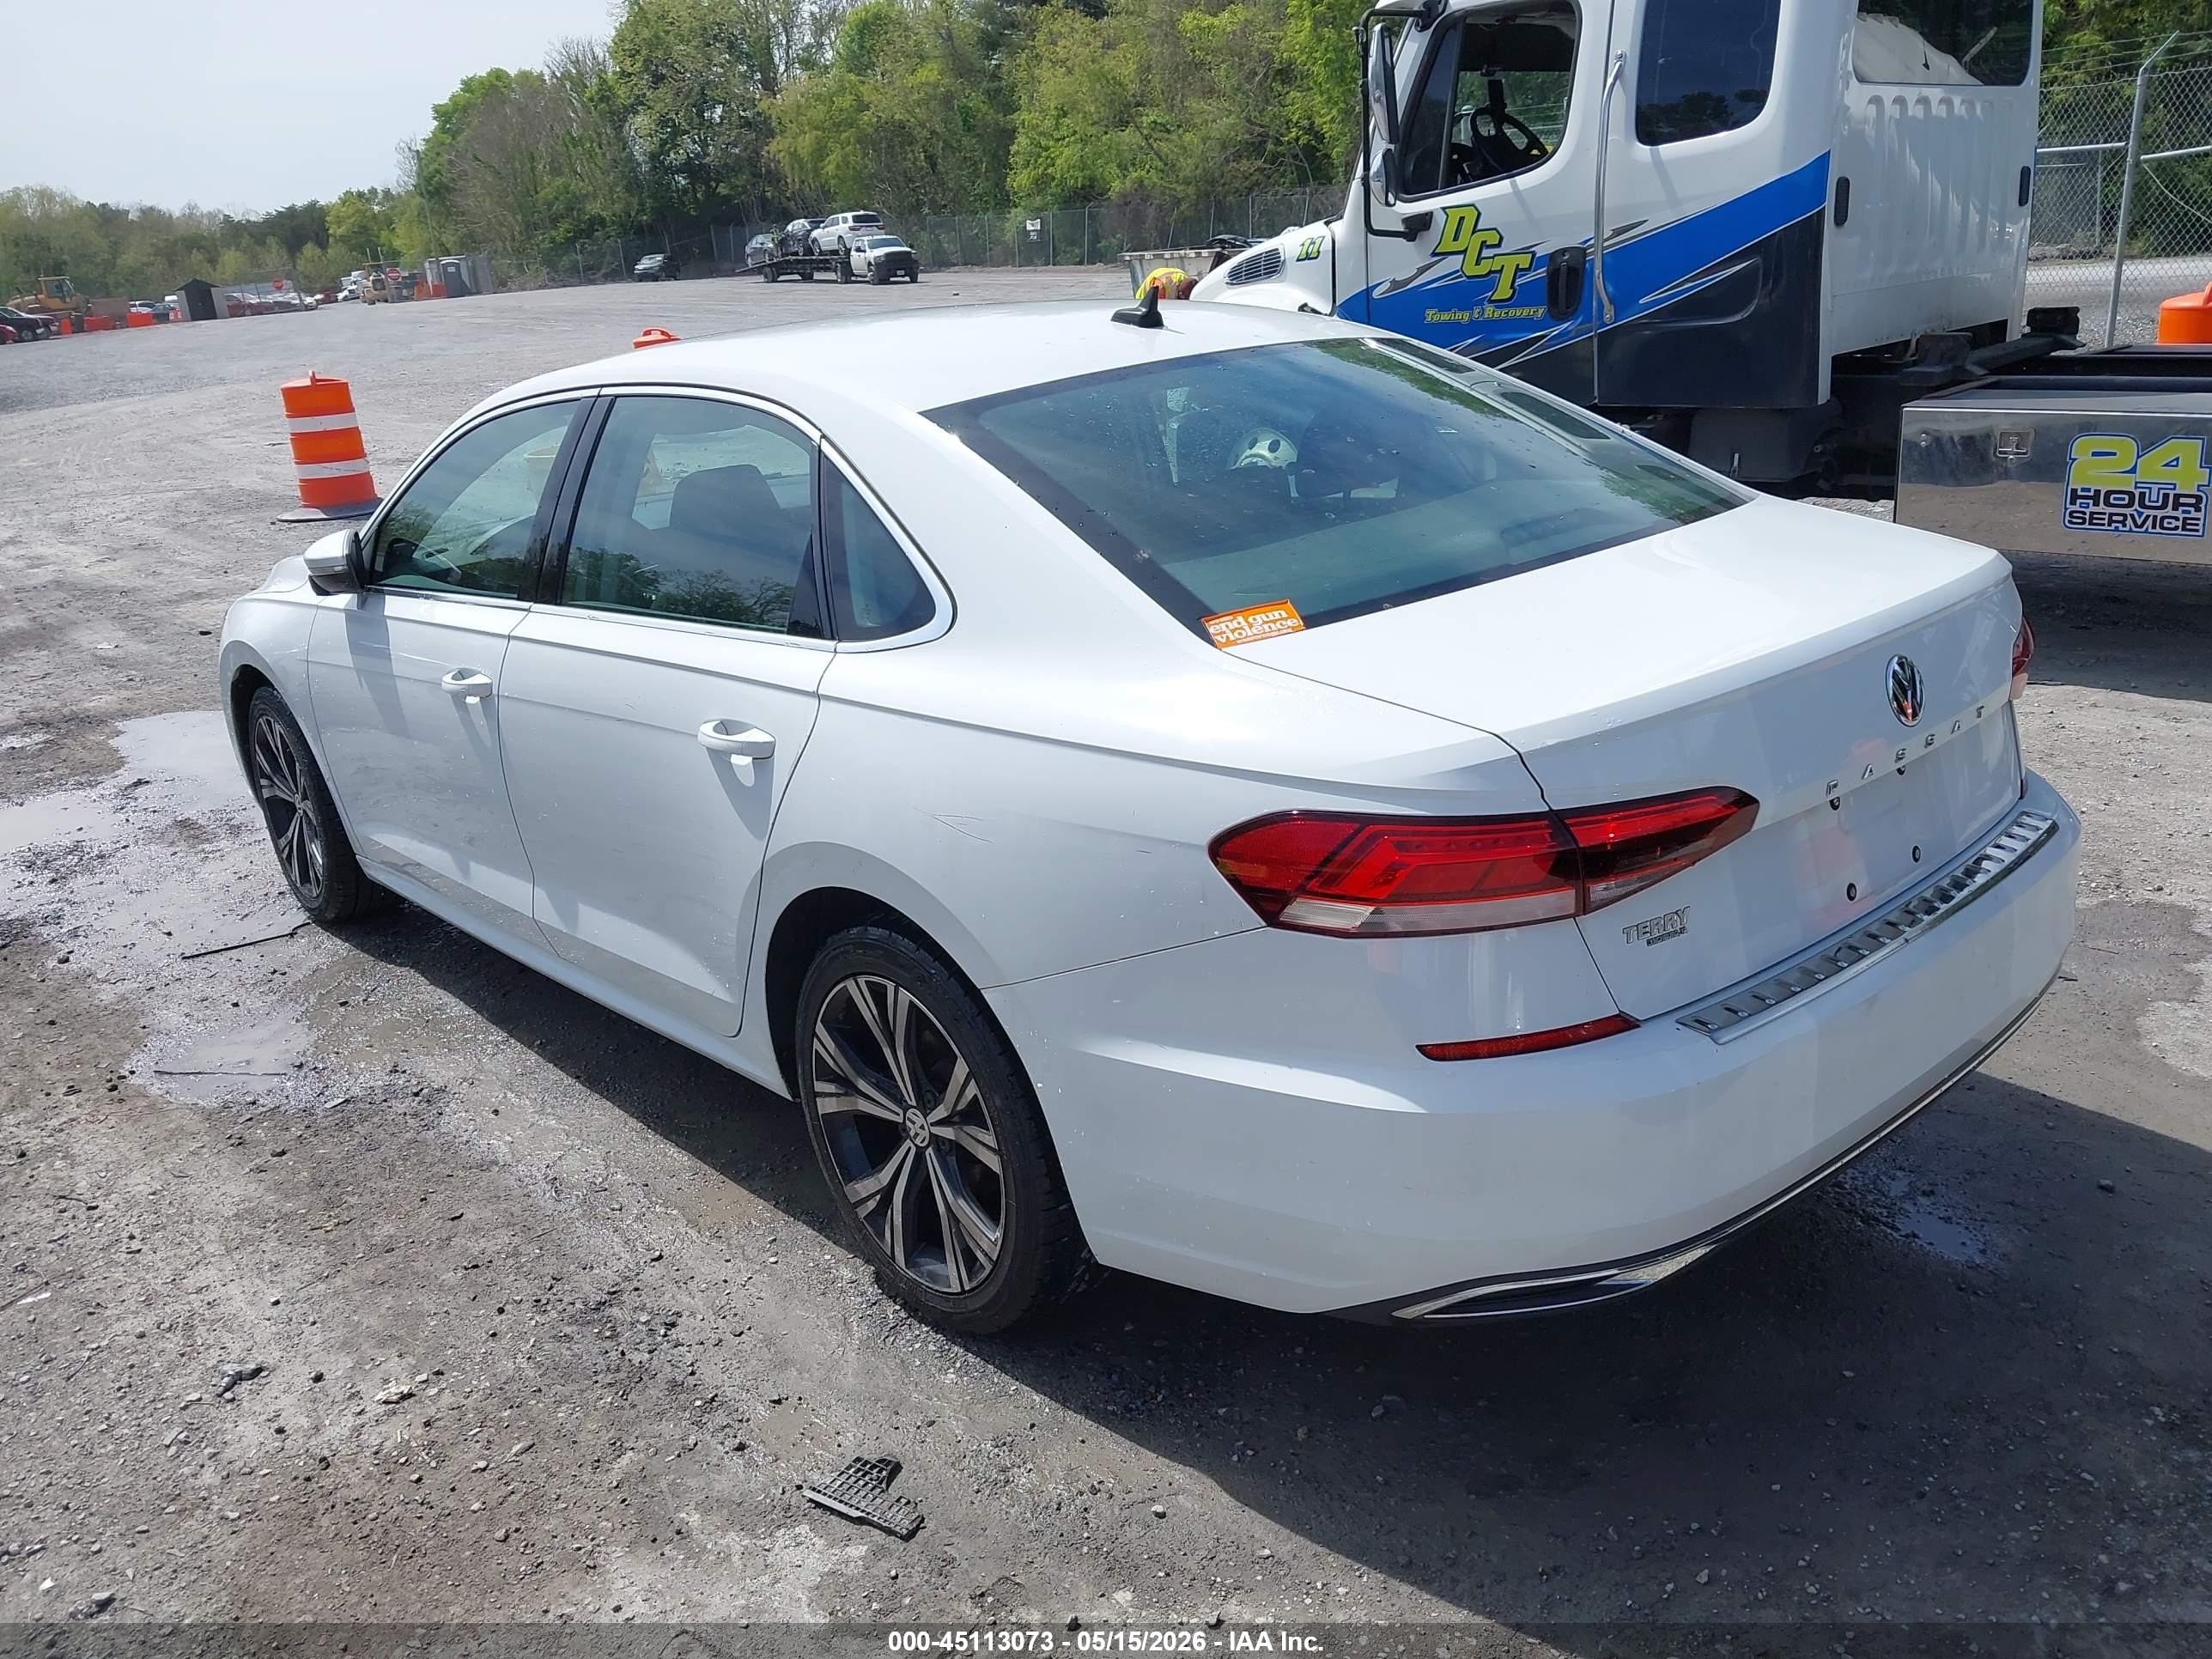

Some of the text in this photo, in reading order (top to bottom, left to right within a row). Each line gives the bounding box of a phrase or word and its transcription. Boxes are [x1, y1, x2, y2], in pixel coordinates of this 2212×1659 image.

[1296, 235, 1326, 262] 11
[1429, 204, 1537, 304] DCT
[1425, 308, 1471, 323] Towing
[1483, 305, 1547, 319] Recovery
[2069, 433, 2210, 491] 24
[2069, 488, 2204, 513] HOUR
[2067, 510, 2202, 532] SERVICE
[1209, 616, 1248, 634] end
[1248, 610, 1289, 626] gun
[1213, 618, 1299, 643] violence
[1826, 705, 1985, 796] PASSAT
[1622, 905, 1690, 945] TERRY
